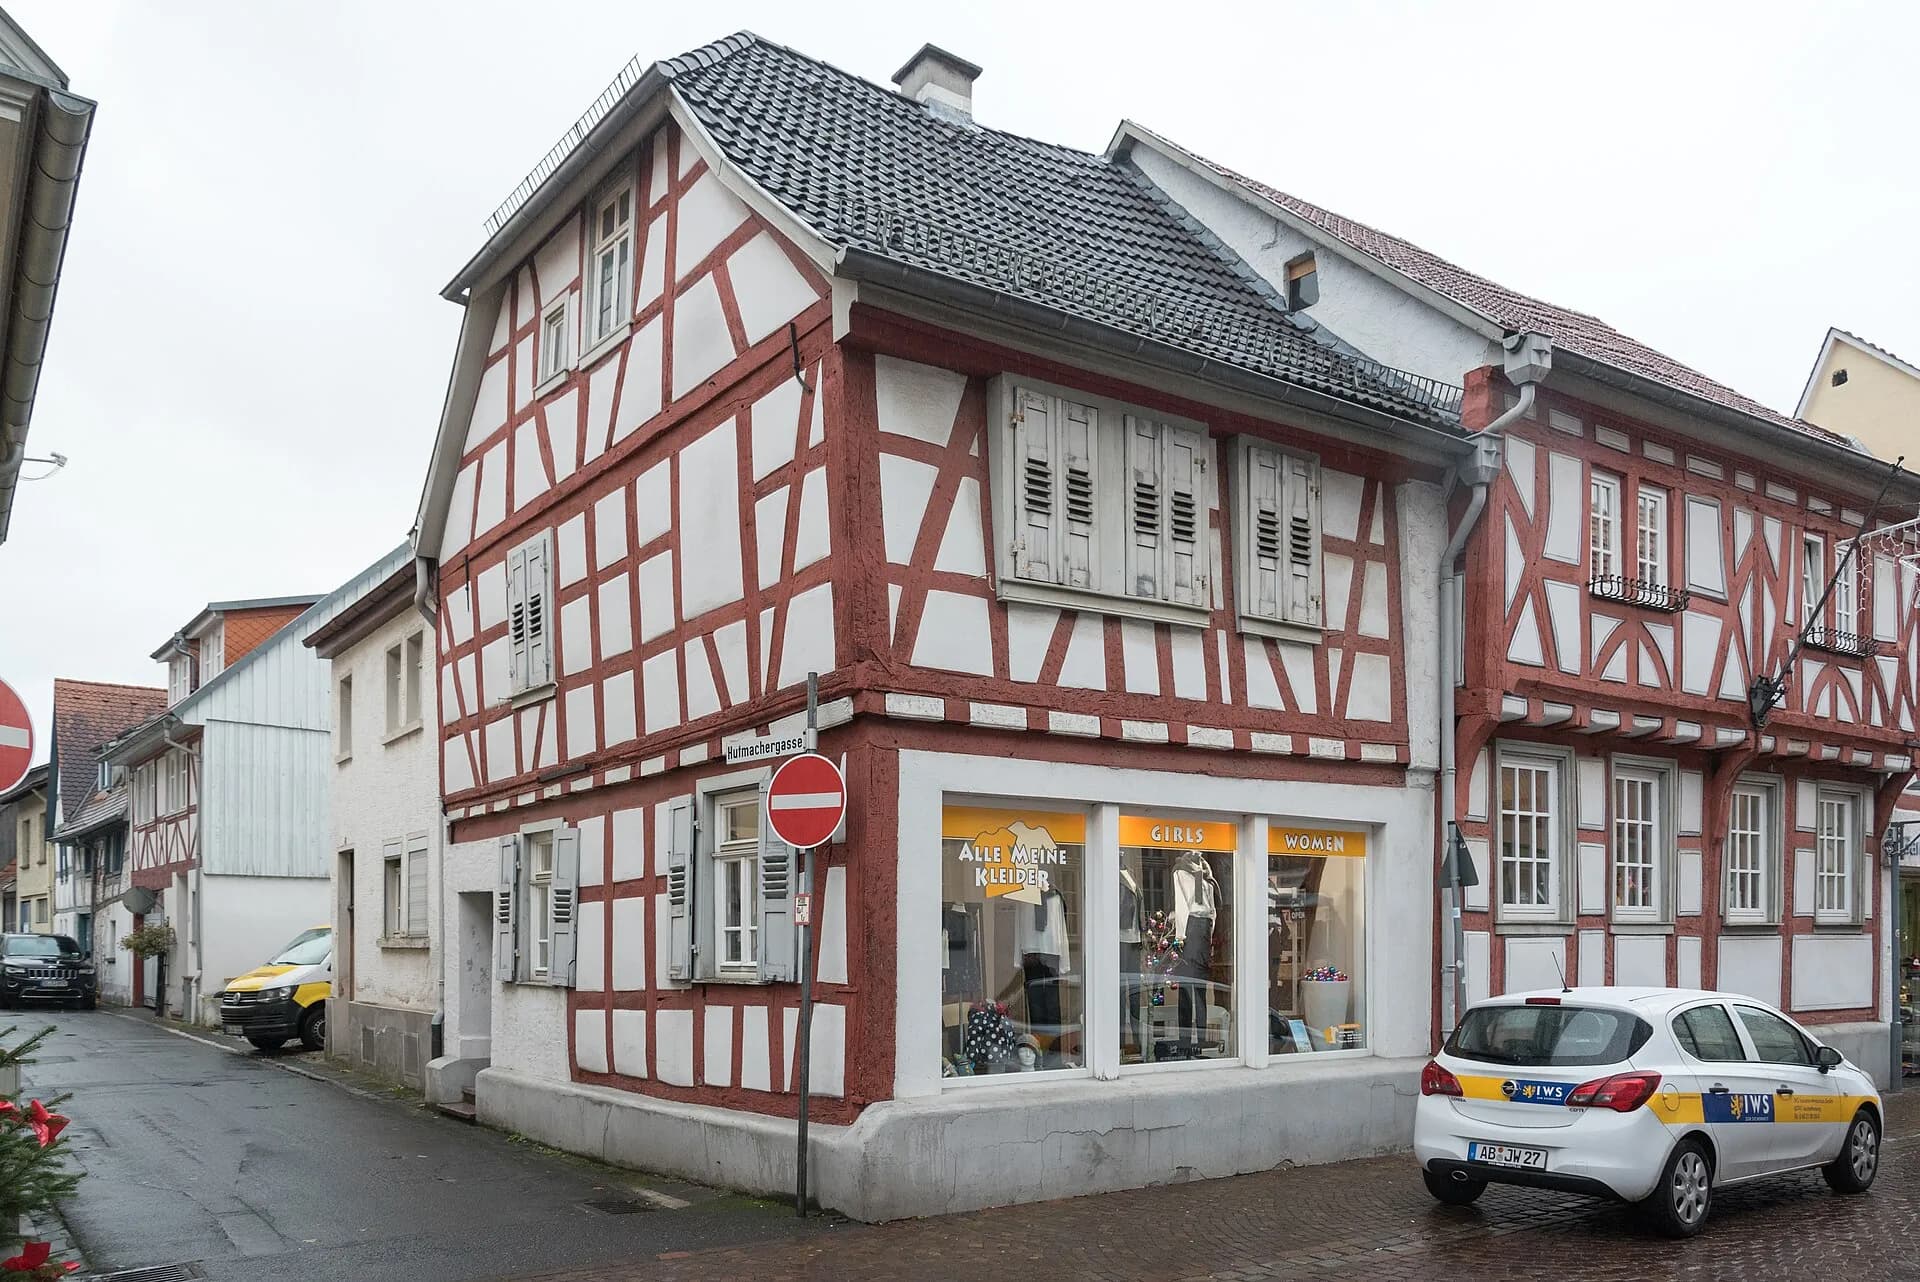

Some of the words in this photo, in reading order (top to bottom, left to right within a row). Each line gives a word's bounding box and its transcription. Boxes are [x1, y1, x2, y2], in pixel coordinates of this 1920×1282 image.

[727, 737, 803, 760] Hutmachergasse
[1151, 825, 1204, 843] GIRLS
[1284, 834, 1345, 852] WOMEN
[958, 842, 1001, 863] ALLE
[1010, 844, 1067, 865] MEINE
[975, 867, 1050, 892] KLEIDER
[1536, 1085, 1563, 1097] IWS
[1744, 1094, 1770, 1114] IWS
[1479, 1146, 1496, 1160] AB
[1504, 1148, 1522, 1163] JW
[1523, 1151, 1541, 1166] 27
